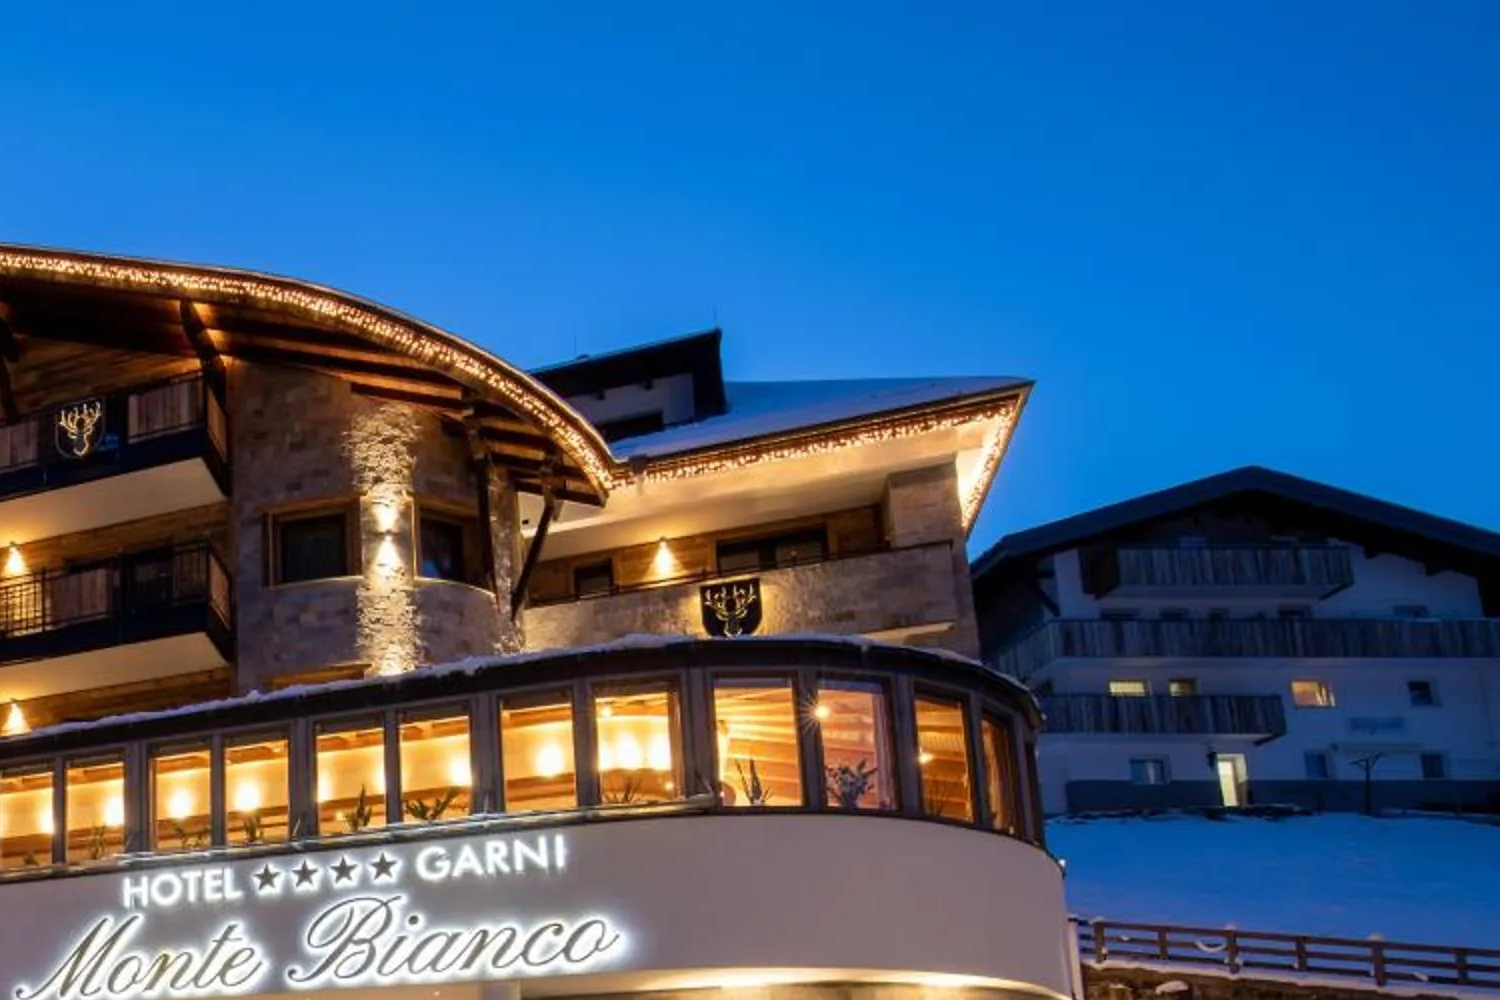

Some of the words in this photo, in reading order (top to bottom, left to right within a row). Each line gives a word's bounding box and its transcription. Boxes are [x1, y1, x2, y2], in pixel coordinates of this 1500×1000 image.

[123, 867, 243, 907] HOTEL
[415, 834, 567, 881] GARNI
[287, 894, 622, 983] Bianco
